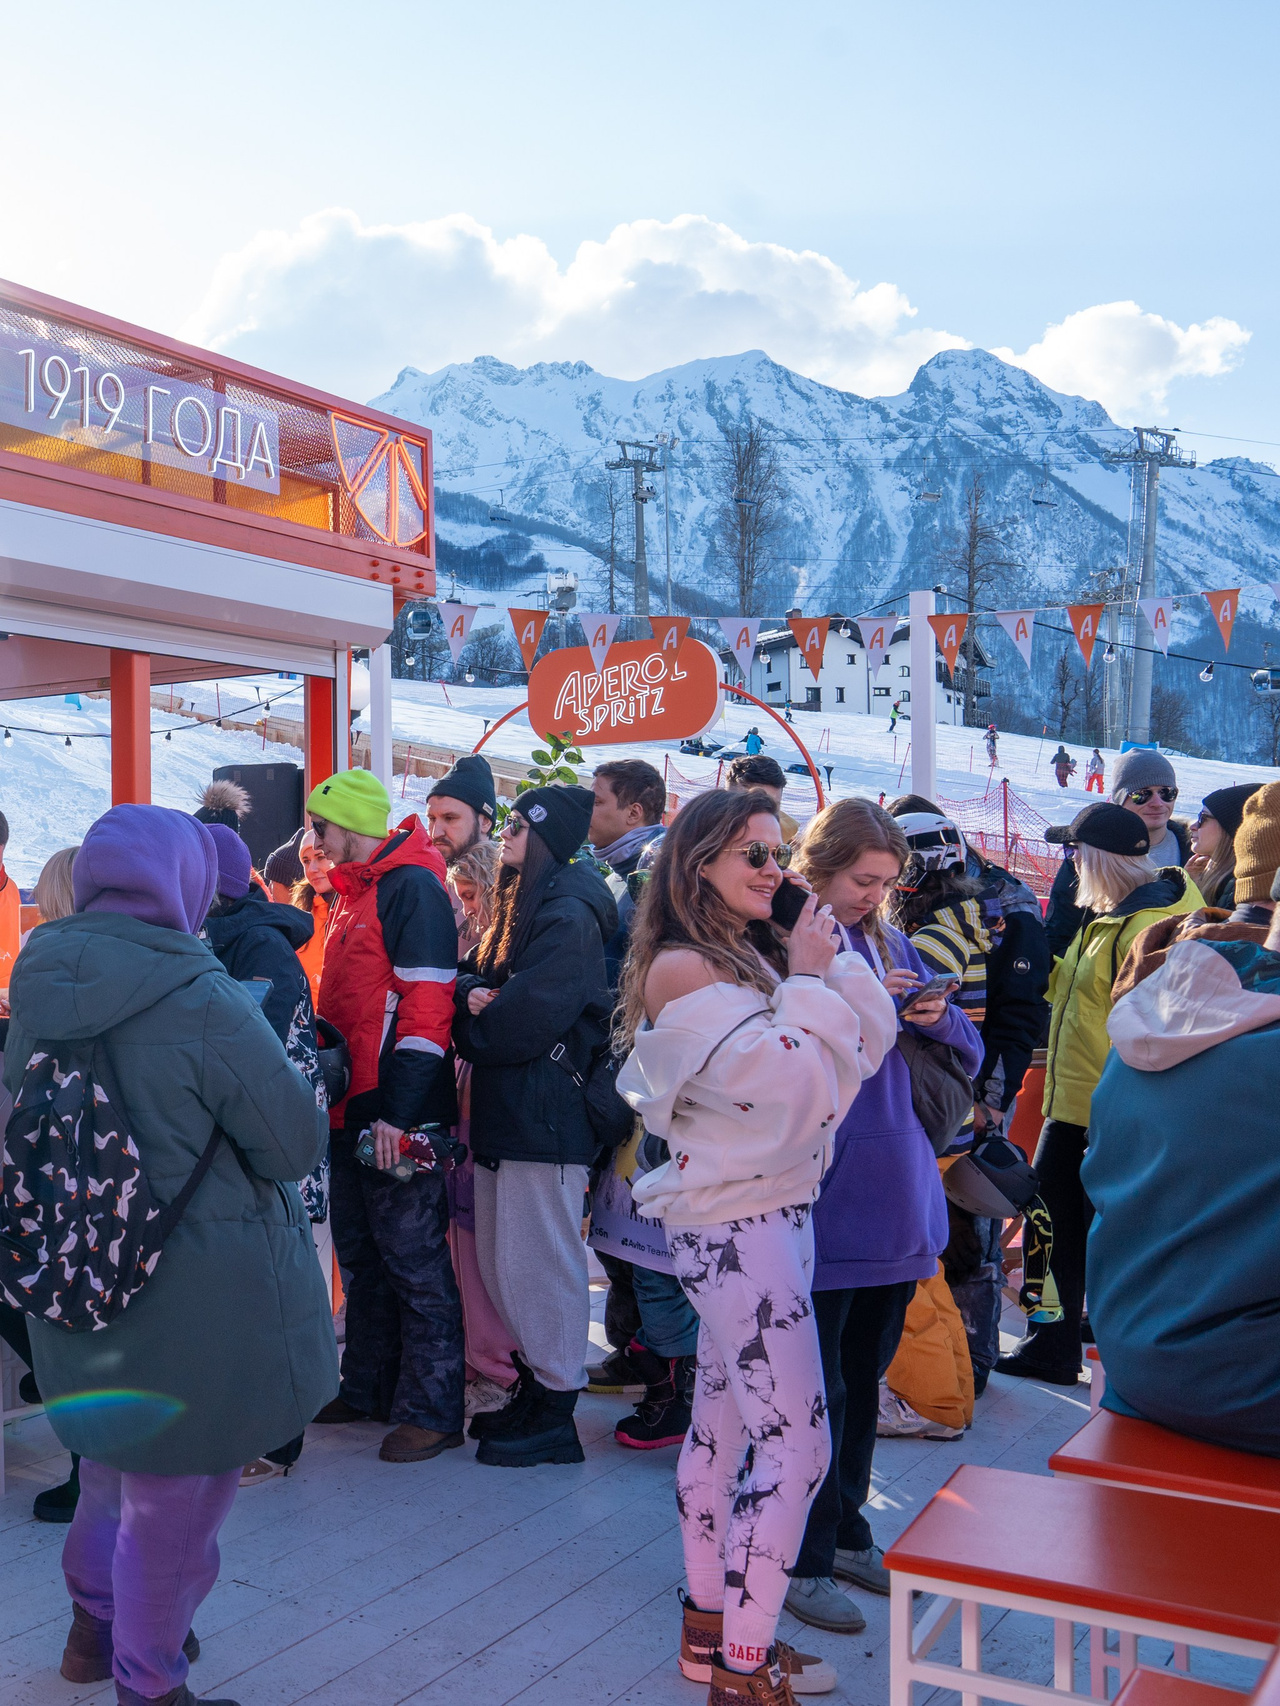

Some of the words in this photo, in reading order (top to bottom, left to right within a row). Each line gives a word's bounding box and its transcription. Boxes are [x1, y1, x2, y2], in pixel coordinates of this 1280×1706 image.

[18, 348, 125, 433] 1919
[145, 385, 275, 481] ГОДА
[1154, 606, 1167, 629] A
[1218, 599, 1231, 623] A
[450, 614, 464, 638] A
[521, 621, 535, 645] A
[592, 624, 607, 648] A
[662, 626, 677, 650] A
[735, 626, 750, 650] A
[869, 626, 884, 649] A
[942, 624, 958, 648] A
[1015, 617, 1028, 641] A
[1079, 614, 1094, 640] A
[805, 626, 820, 652] A
[554, 653, 687, 720] APEROL
[729, 1643, 768, 1662] ЗАБЕ
